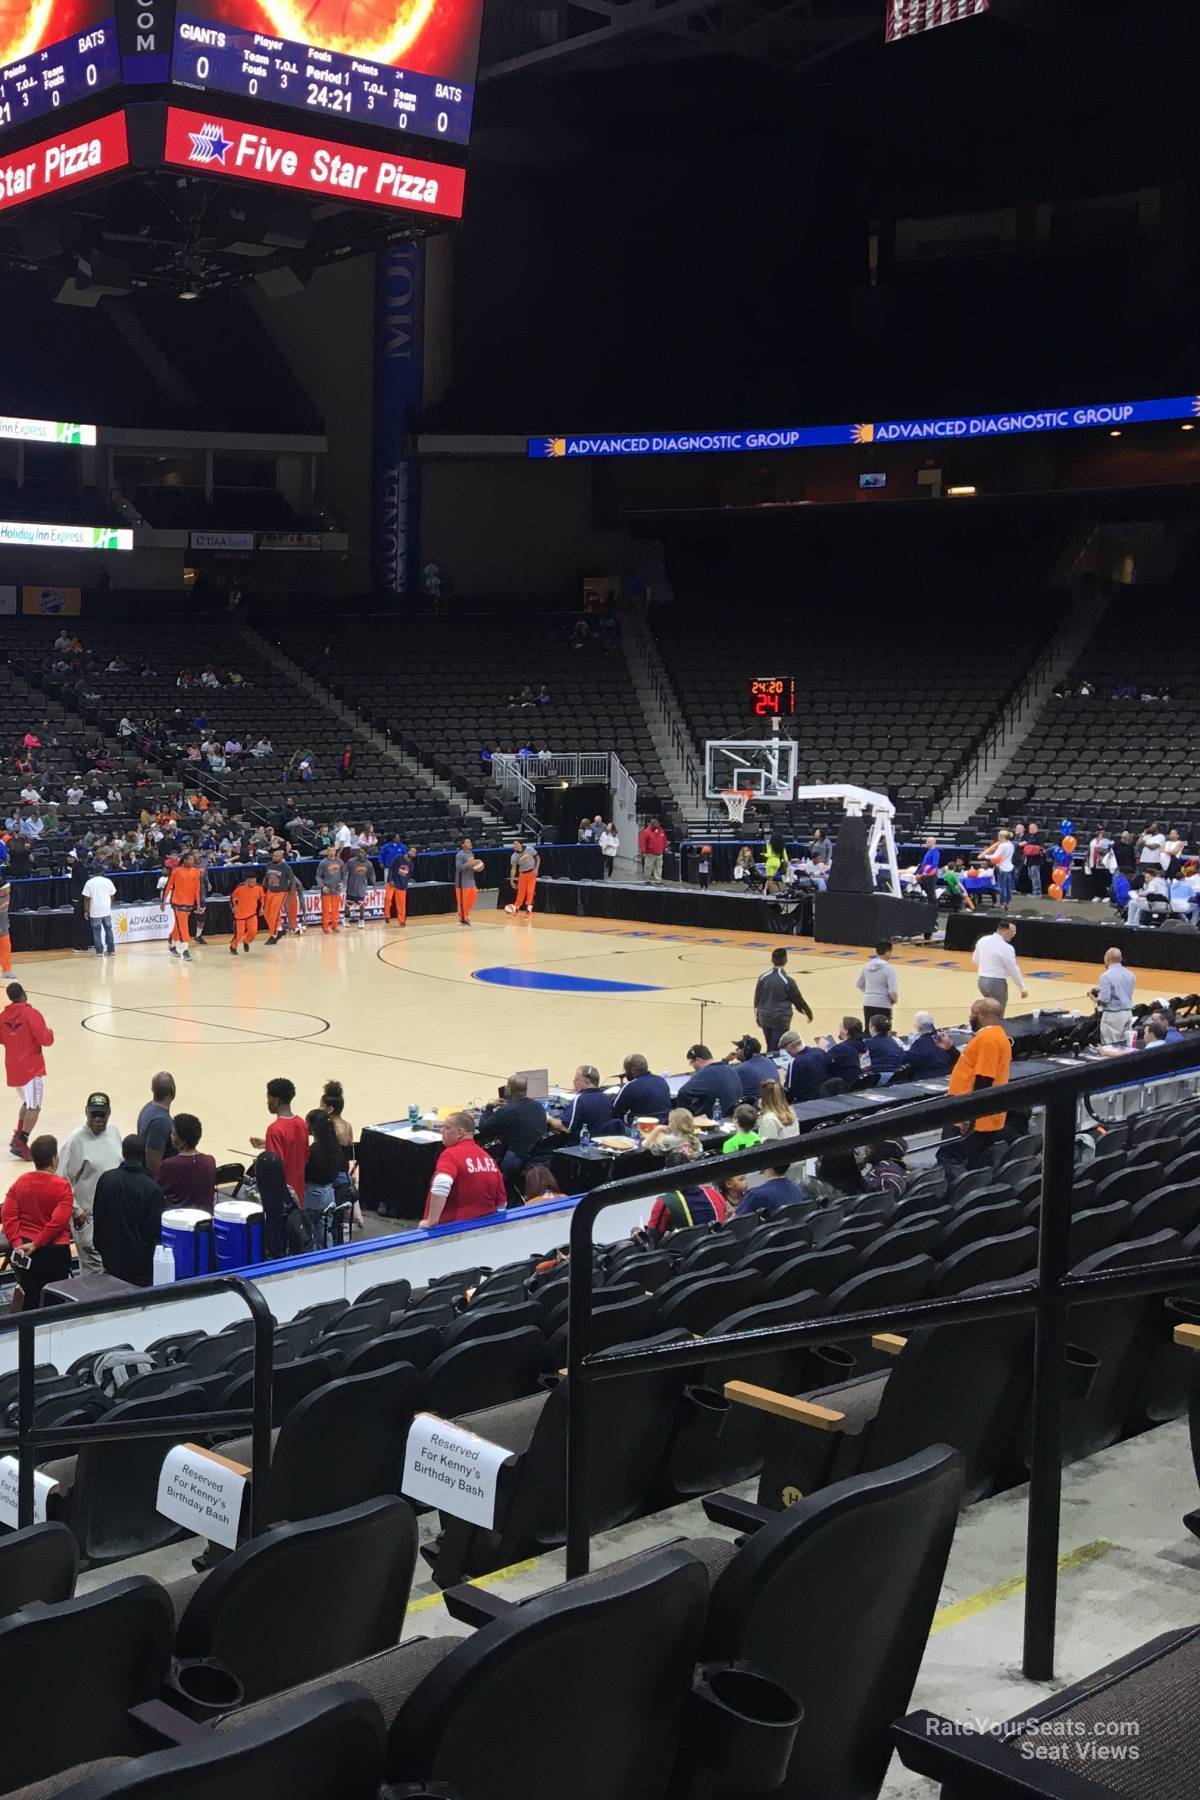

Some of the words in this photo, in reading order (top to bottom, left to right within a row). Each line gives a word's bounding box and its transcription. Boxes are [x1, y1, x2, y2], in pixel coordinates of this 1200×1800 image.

[79, 30, 105, 53] BATS
[180, 23, 226, 48] GIANTS
[243, 50, 269, 65] Team
[254, 35, 284, 50] Player
[308, 48, 332, 63] Fouls
[352, 61, 378, 77] Points
[4, 64, 26, 80] Points
[42, 65, 64, 80] Team
[86, 64, 97, 86] 0
[197, 56, 209, 79] 0
[242, 62, 267, 77] Fouls
[306, 66, 342, 85] Period
[44, 75, 65, 89] Fouls
[249, 79, 258, 95] 0
[280, 74, 288, 89] 3
[22, 93, 29, 107] 3
[53, 91, 60, 107] 0
[307, 83, 352, 112] 24:21
[394, 88, 417, 102] Team
[435, 83, 462, 102] BATS
[367, 96, 375, 110] 3
[394, 98, 416, 112] Fouls
[400, 113, 407, 129] 0
[437, 112, 448, 132] 0
[45, 139, 102, 183] Pizza
[236, 133, 298, 176] Five
[311, 150, 369, 189] Star
[376, 162, 439, 205] Pizza
[0, 421, 13, 432] Inn
[15, 422, 48, 436] Express
[876, 421, 966, 440] ADVANCED
[969, 412, 1068, 434] DIAGNOSTIC
[1073, 406, 1134, 425] GROUP
[567, 438, 650, 454] ADVANCED
[652, 435, 741, 451] DIAGNOSTIC
[745, 432, 799, 448] GROUP
[1, 526, 35, 541] Holiday
[36, 529, 50, 540] Inn
[50, 529, 85, 543] Express
[751, 681, 784, 694] 24:20
[756, 694, 779, 714] 24
[130, 915, 169, 925] ADVANCED
[430, 1433, 481, 1461] Reserved
[421, 1446, 438, 1462] For
[440, 1452, 482, 1480] Kenny's
[1, 1480, 12, 1490] For
[182, 1464, 224, 1493] Reserved
[413, 1461, 456, 1490] Birthday
[458, 1478, 485, 1499] Bash
[173, 1474, 190, 1490] For
[191, 1482, 227, 1510] Kenny's
[166, 1485, 205, 1517] Birthday
[204, 1504, 230, 1526] Bash
